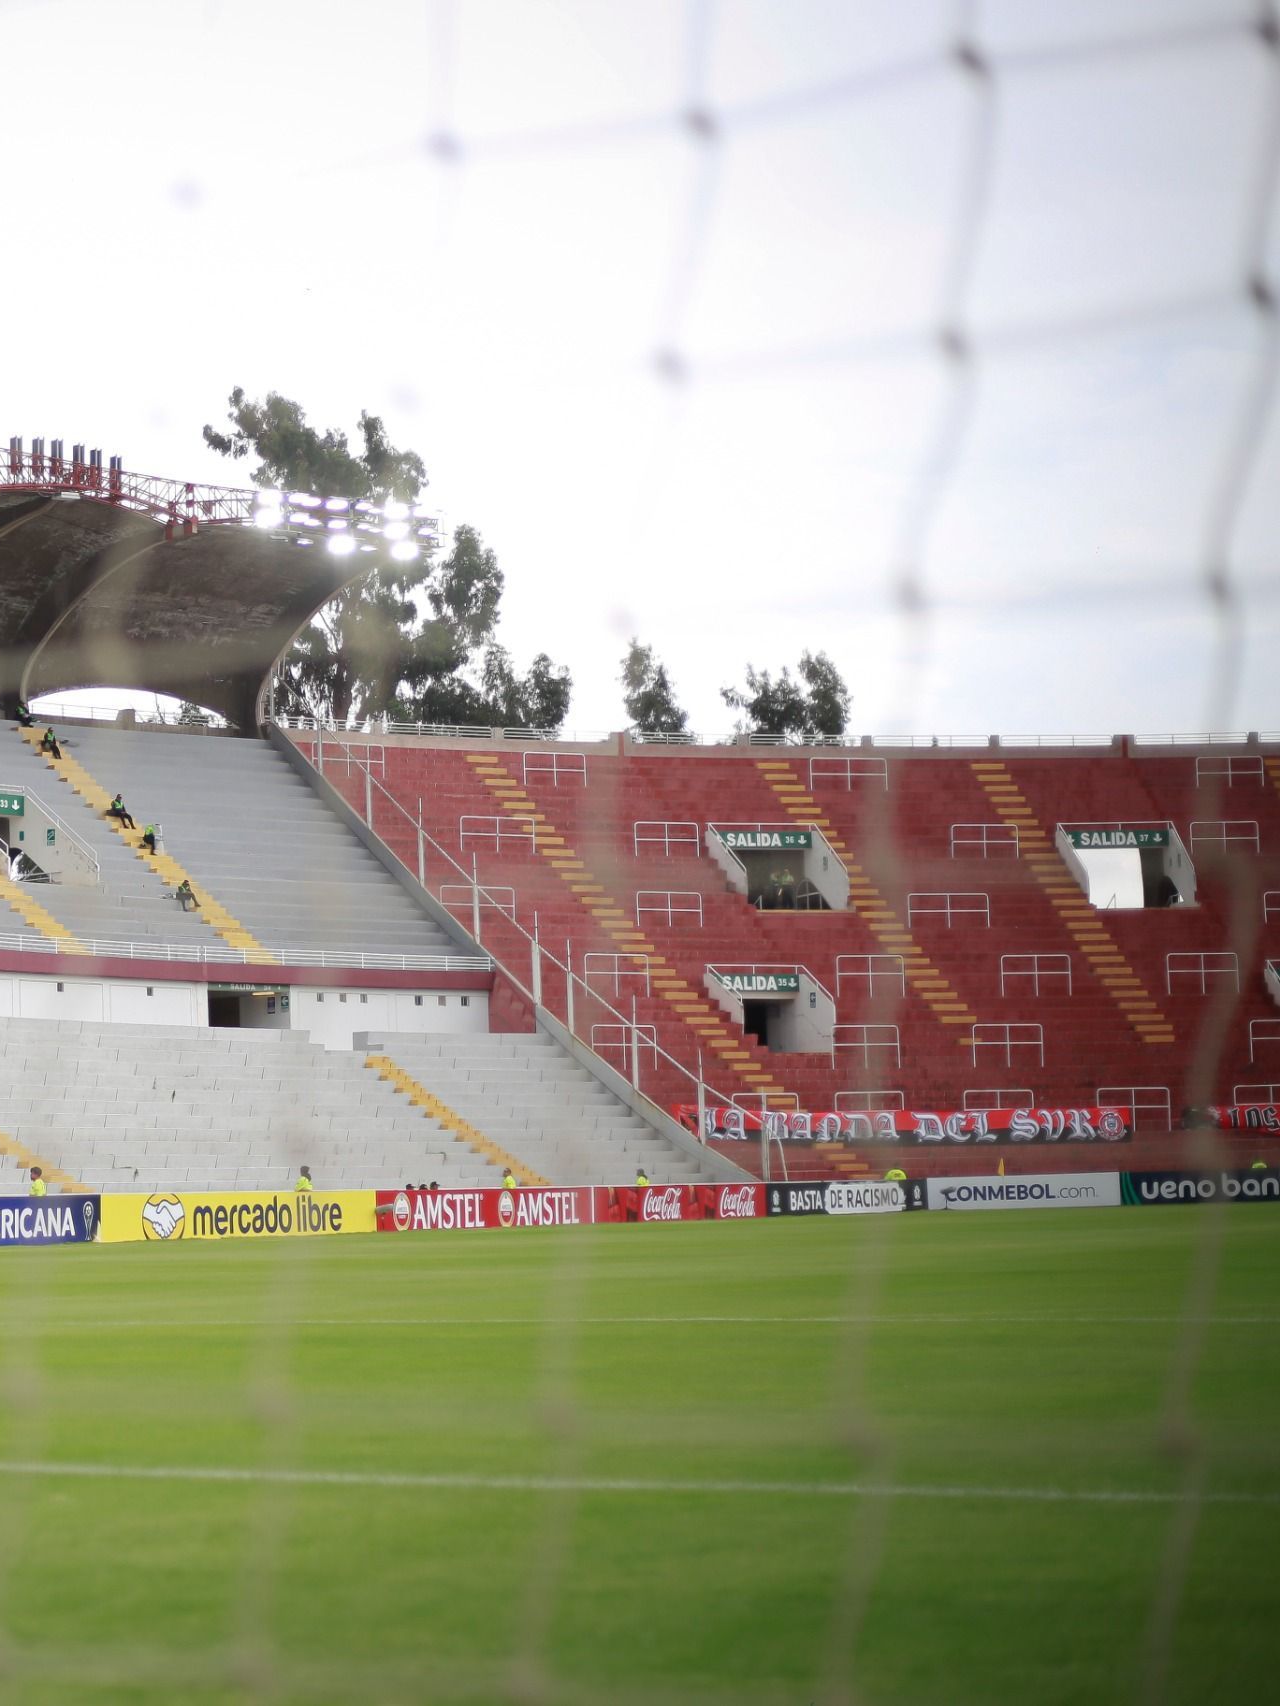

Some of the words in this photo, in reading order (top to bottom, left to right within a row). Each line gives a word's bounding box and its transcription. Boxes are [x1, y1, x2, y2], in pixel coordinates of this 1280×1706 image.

[726, 832, 783, 847] SALIDA
[785, 835, 795, 844] 36
[1081, 831, 1138, 846] SALIDA
[1140, 834, 1149, 842] 37
[722, 975, 779, 991] SALIDA
[704, 1109, 747, 1142] LA
[764, 1110, 901, 1143] BANDA
[911, 1110, 999, 1144] DEL
[789, 1189, 824, 1211] BASTA
[830, 1189, 845, 1209] DE
[847, 1187, 900, 1209] RACISMO
[943, 1184, 1096, 1203] CONMEBOL.com
[1141, 1179, 1216, 1201] ueno
[193, 1195, 293, 1236] mercado
[295, 1194, 343, 1233] libre
[412, 1193, 485, 1230] AMSTEL
[516, 1192, 580, 1226] AMSTEL
